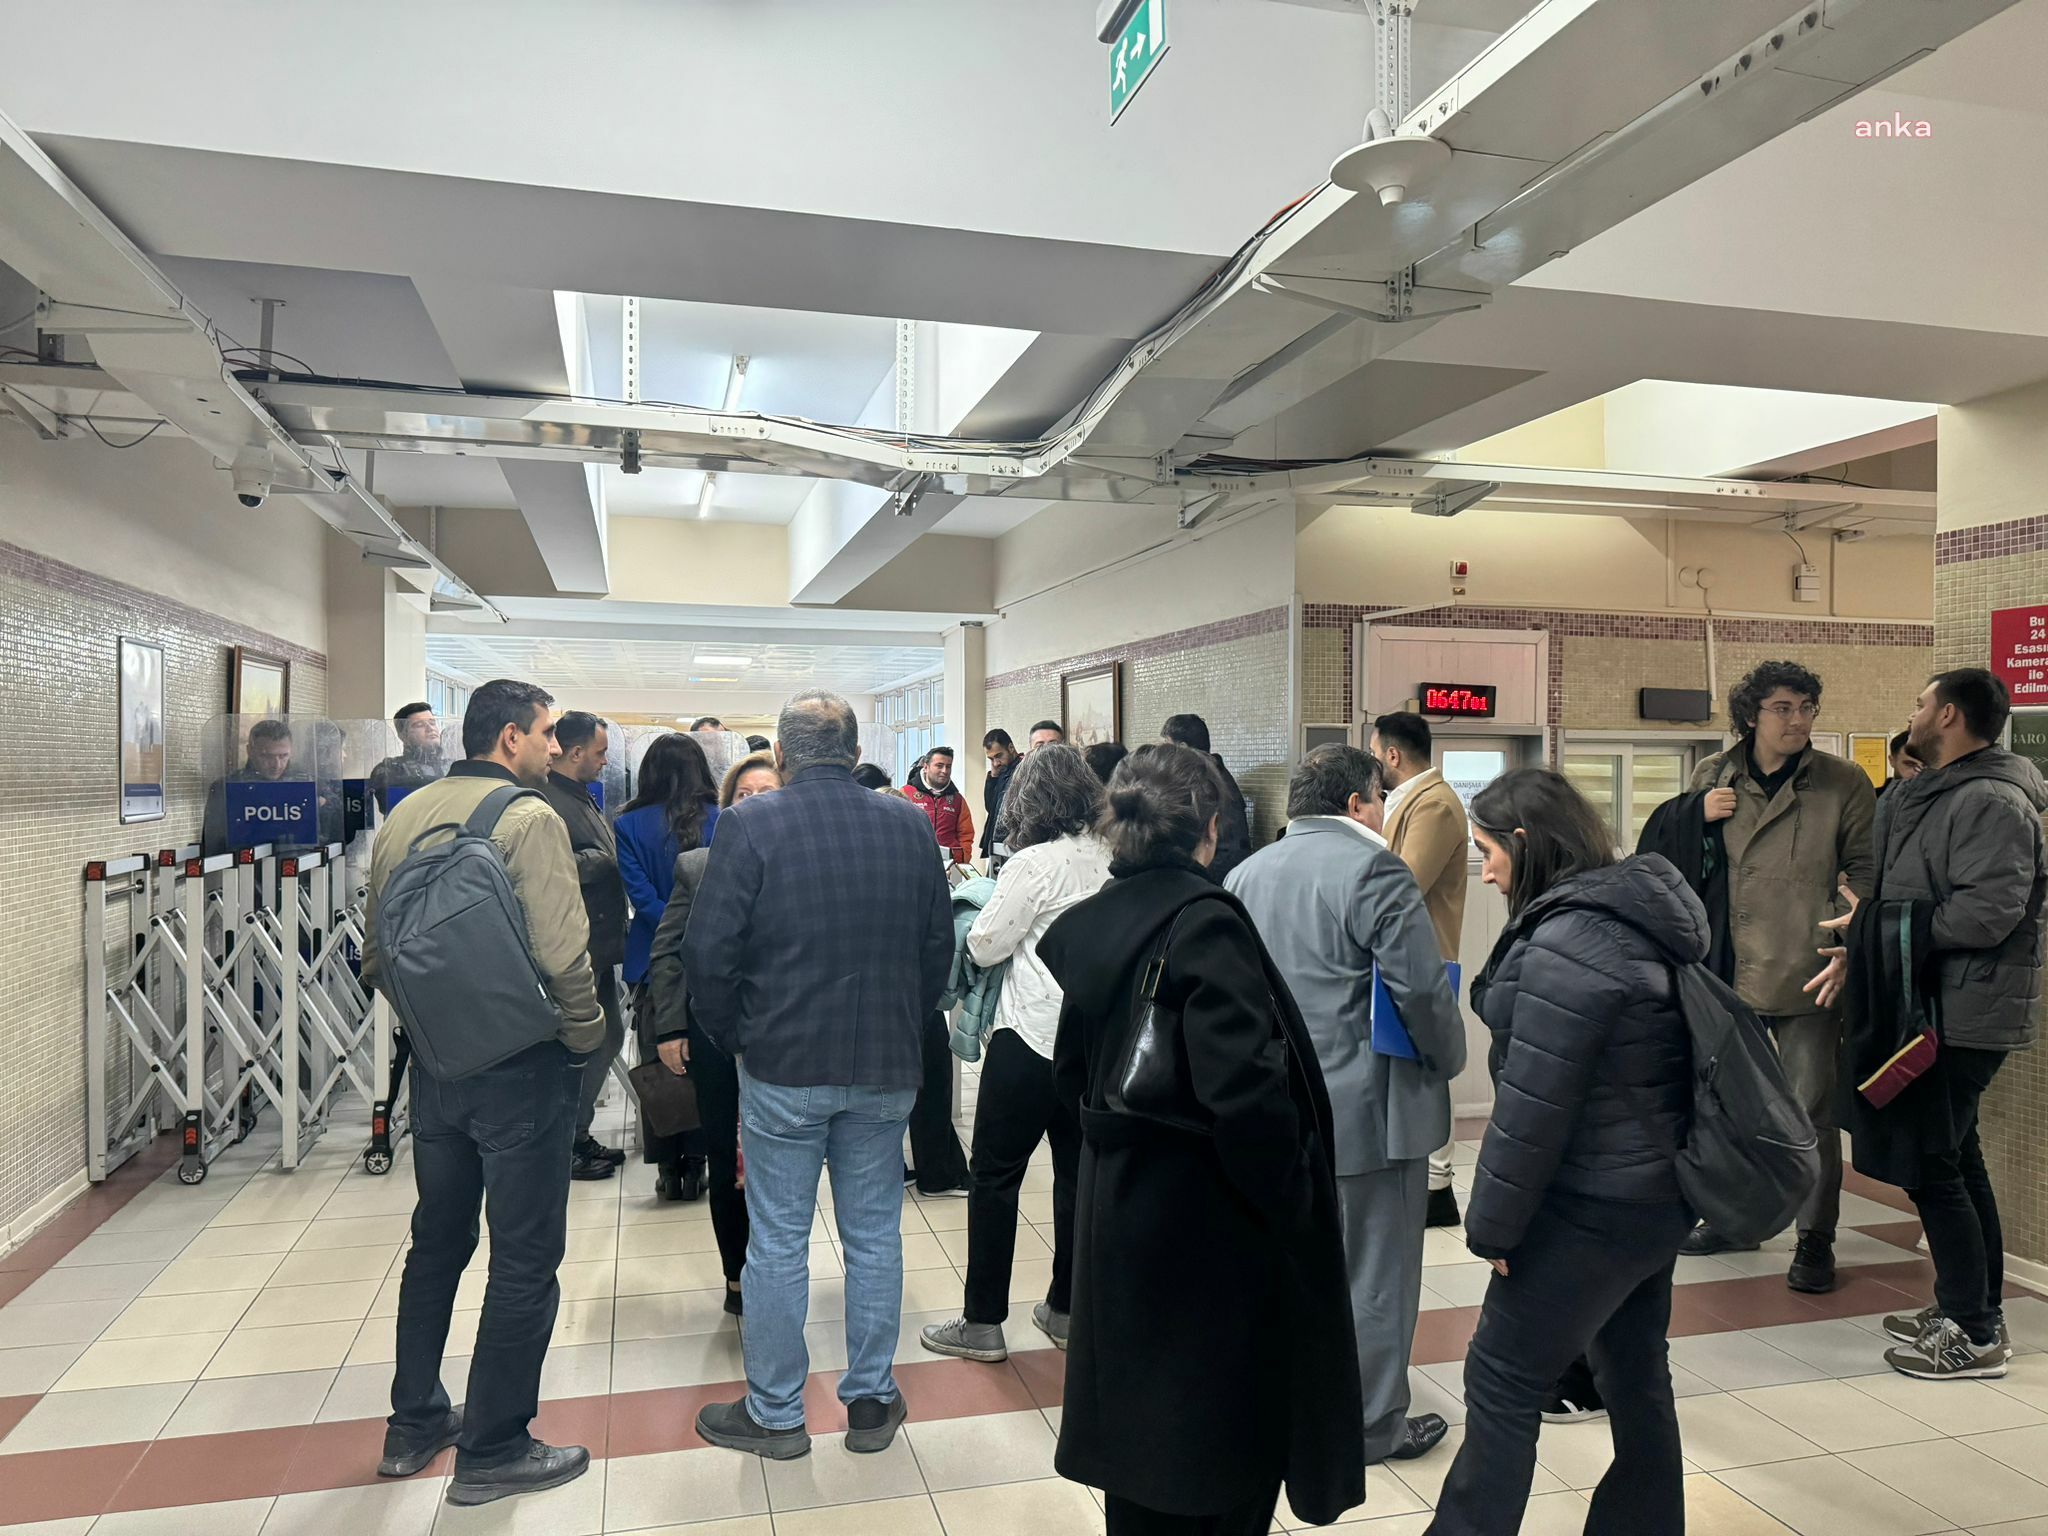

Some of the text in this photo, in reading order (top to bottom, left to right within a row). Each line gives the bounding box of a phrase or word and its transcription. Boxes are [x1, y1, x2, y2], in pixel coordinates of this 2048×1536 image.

[2029, 616, 2045, 627] Bu
[2030, 629, 2046, 640] 24
[2014, 643, 2048, 655] Esası
[2028, 669, 2044, 680] ile
[2014, 682, 2048, 694] Edilm
[244, 803, 302, 821] POLİS
